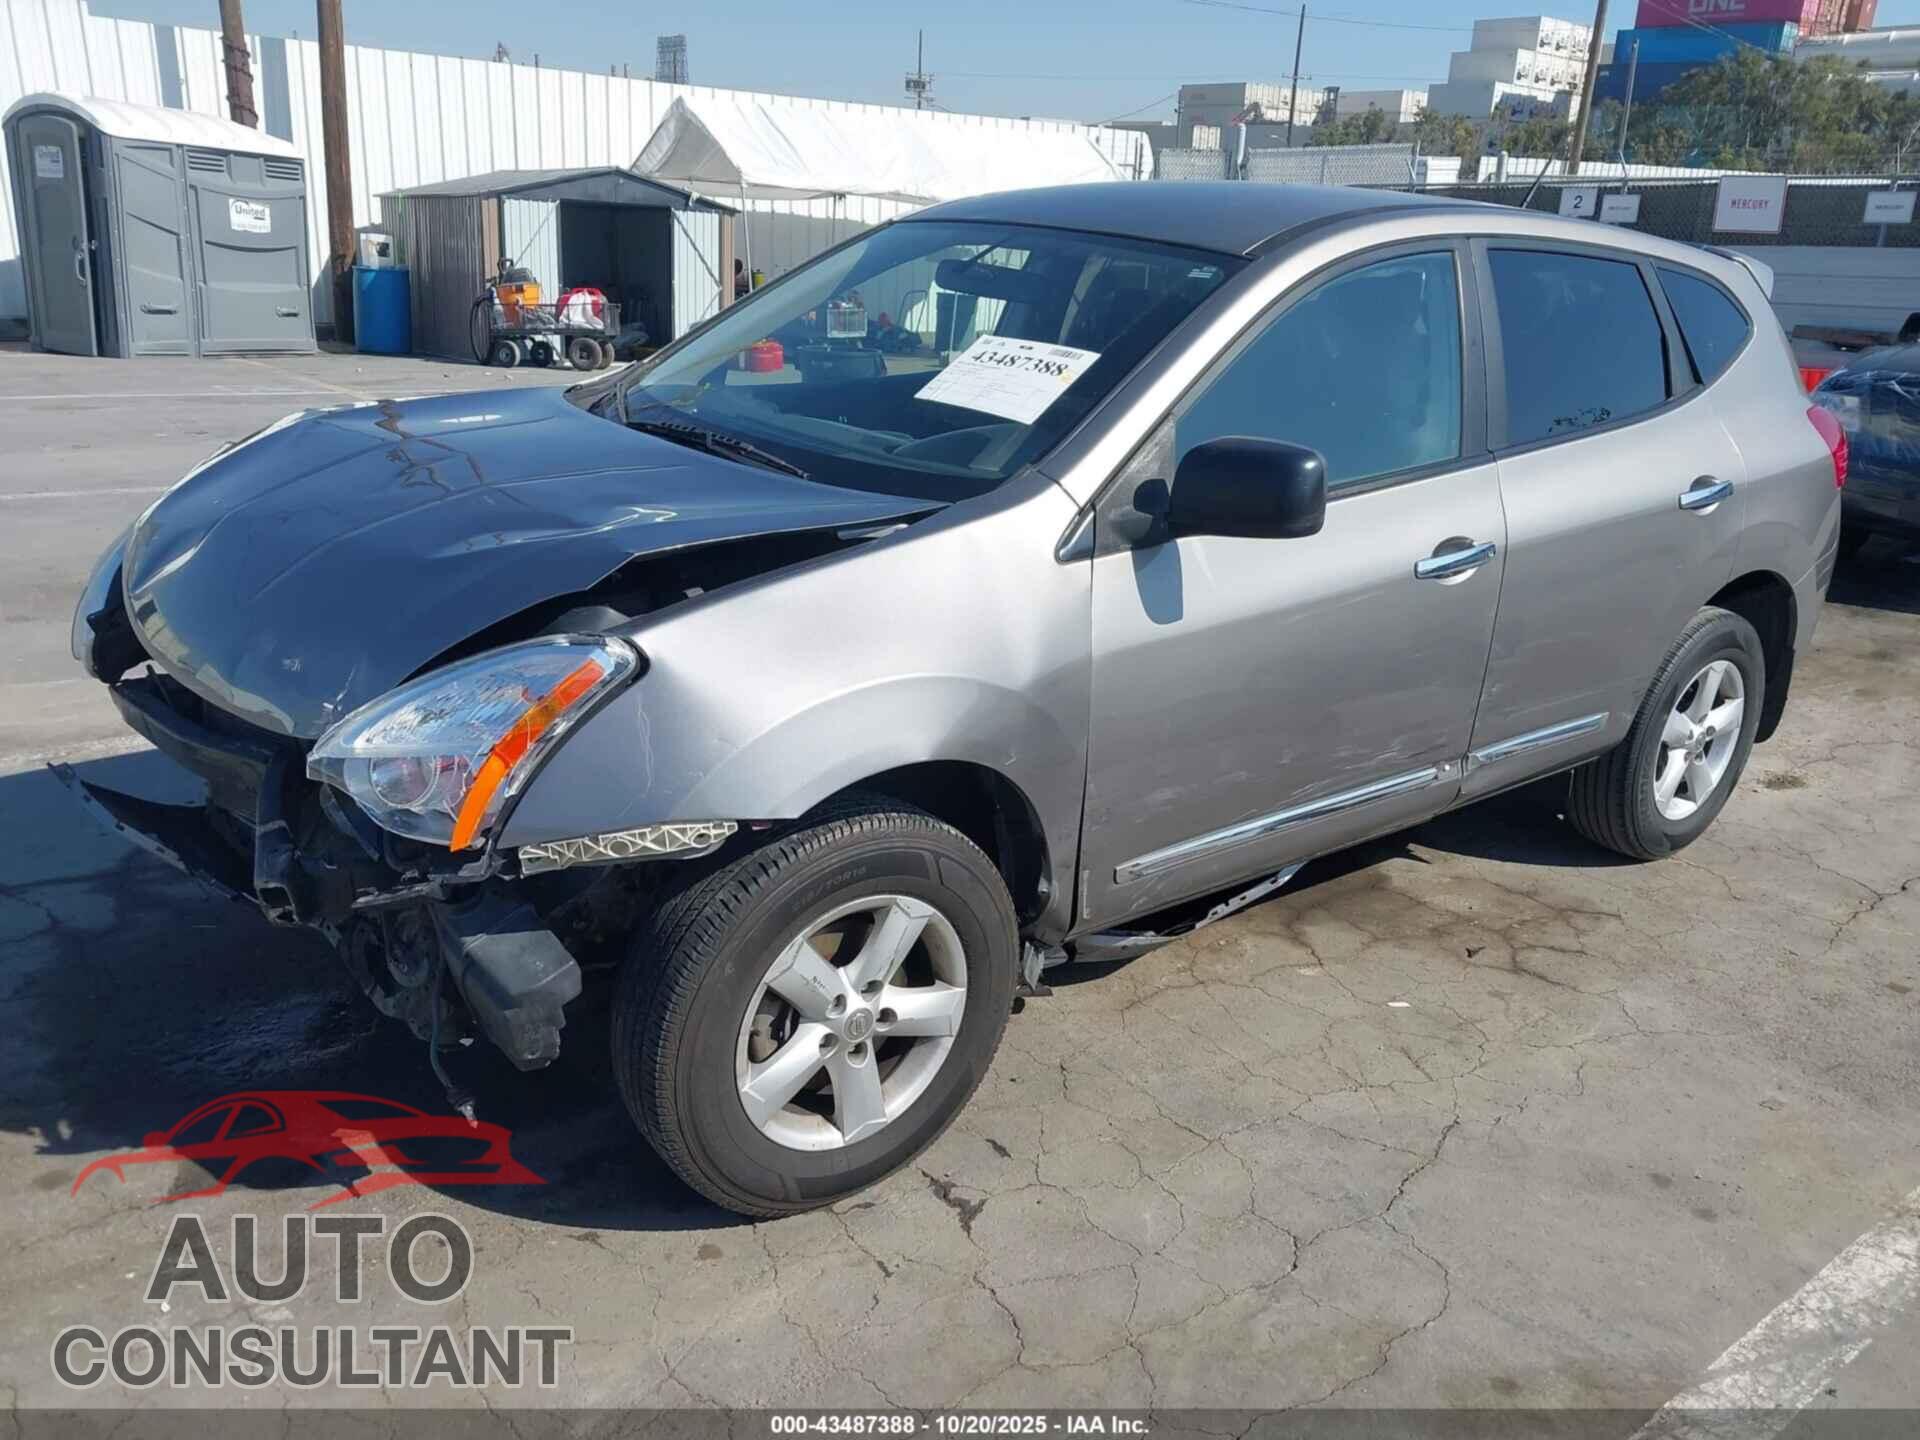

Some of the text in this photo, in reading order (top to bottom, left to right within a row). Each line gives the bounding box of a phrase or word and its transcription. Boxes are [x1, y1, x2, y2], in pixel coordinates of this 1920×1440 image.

[1573, 195, 1584, 209] 2
[1730, 198, 1769, 210] MERCURY
[234, 204, 265, 217] United
[971, 350, 1069, 376] 43487388
